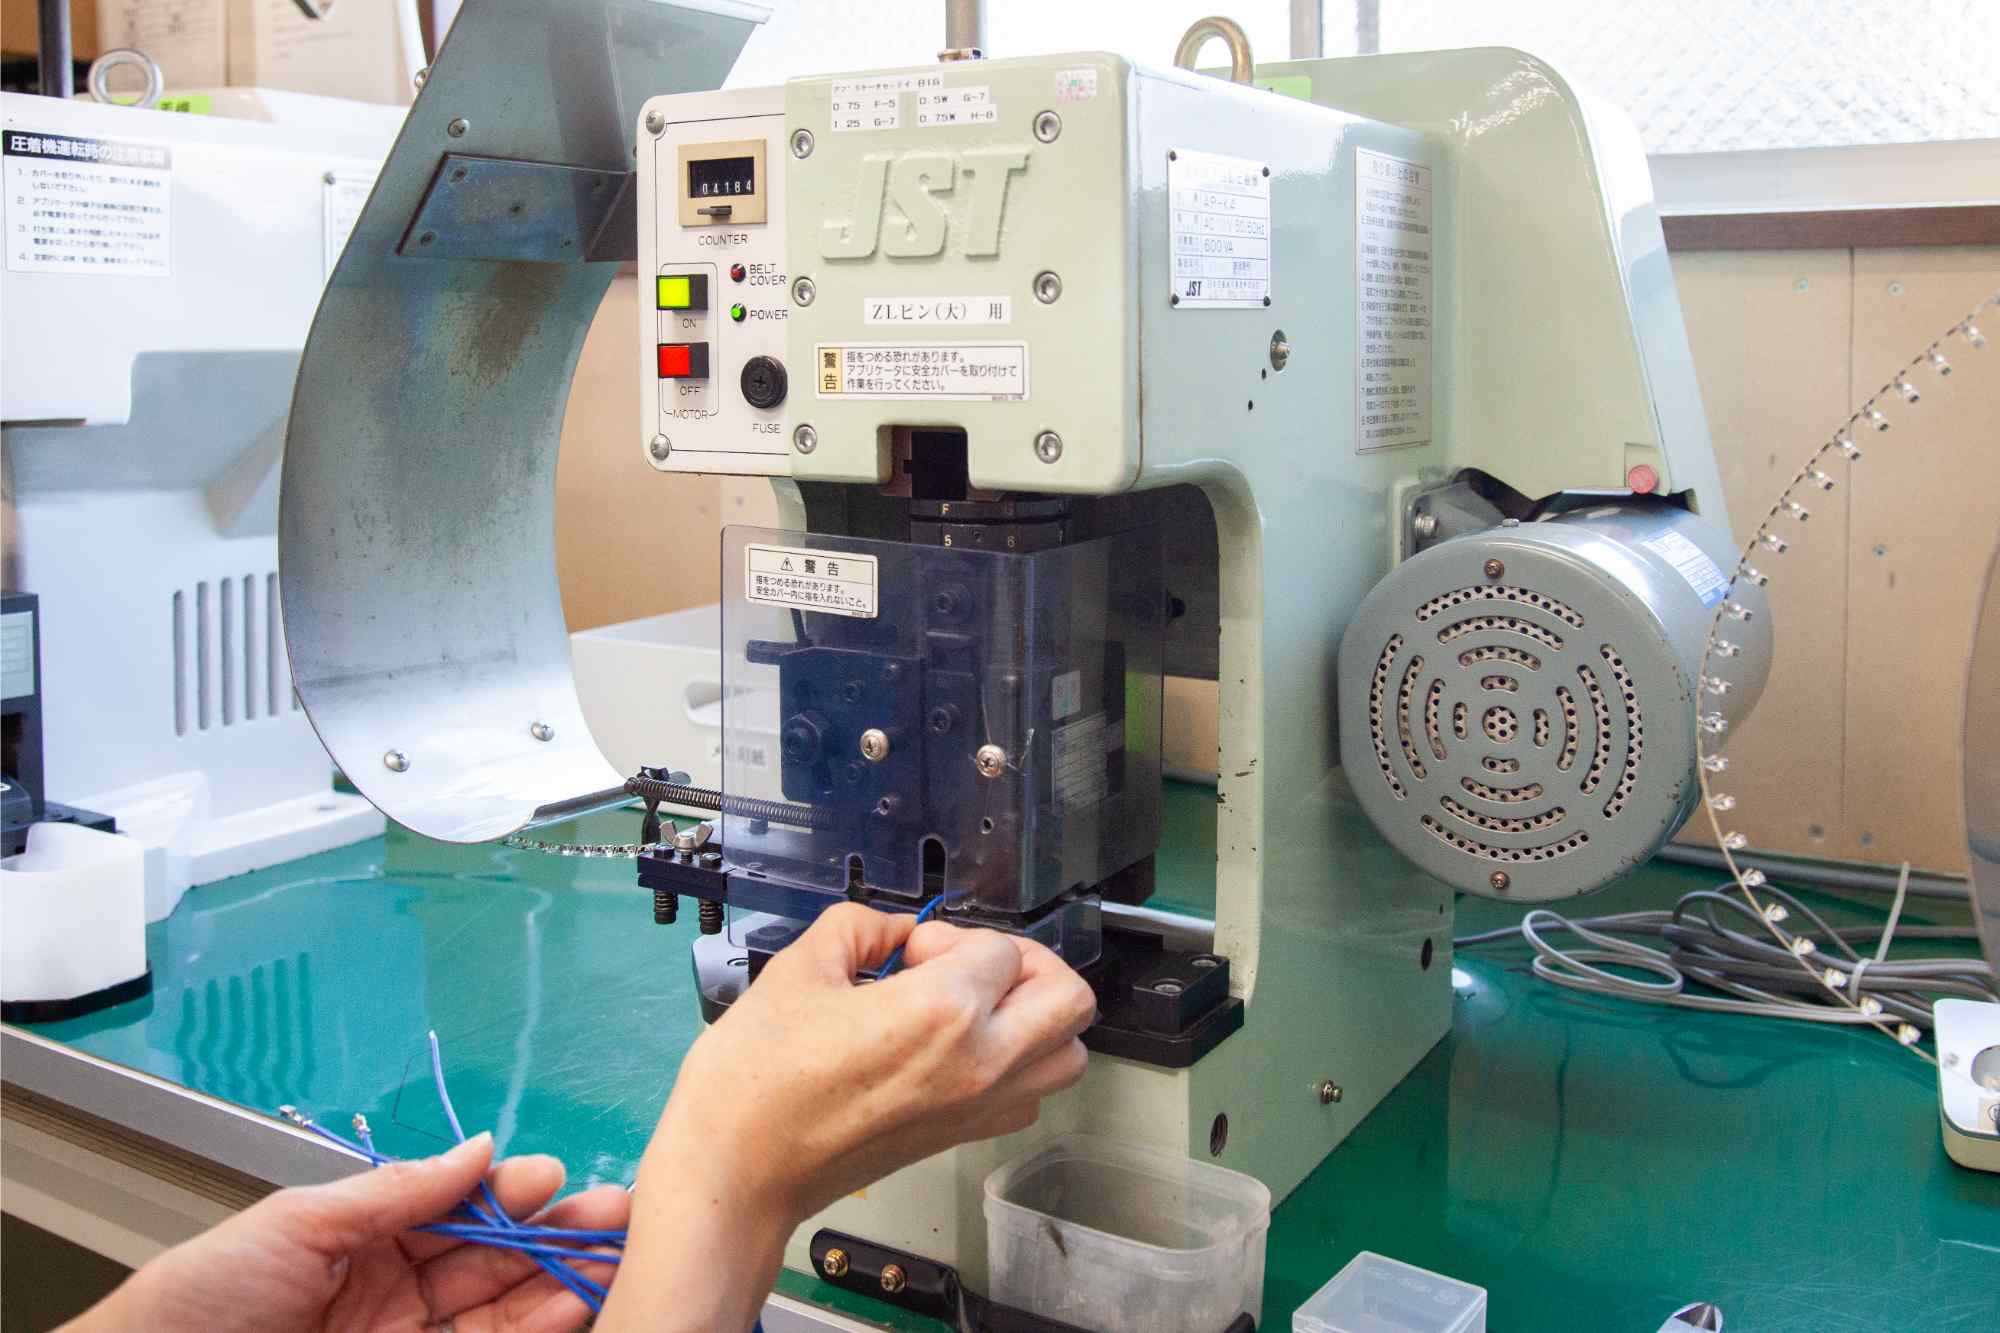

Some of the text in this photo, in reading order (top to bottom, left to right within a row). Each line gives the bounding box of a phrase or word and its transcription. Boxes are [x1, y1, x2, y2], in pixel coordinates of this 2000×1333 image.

[11, 135, 165, 163] 圧着機運転時の注
[822, 146, 1033, 264] JST
[697, 233, 749, 246] COUNTER
[749, 263, 776, 274] BELT
[750, 274, 787, 286] COVER
[1186, 281, 1203, 297] JST
[750, 309, 789, 320] POWER
[988, 302, 1003, 320] 用
[682, 318, 697, 329] ON
[846, 350, 965, 363] 指をつめる恐れがあります。
[823, 351, 838, 391] 警告
[846, 364, 1017, 377] アプリケータに安全カバーを取り付けて
[679, 385, 701, 397] OFF
[846, 377, 946, 392] 作業を行ってください。
[673, 408, 708, 420] MOTOR
[752, 422, 781, 434] FUSE
[943, 534, 952, 547] 5
